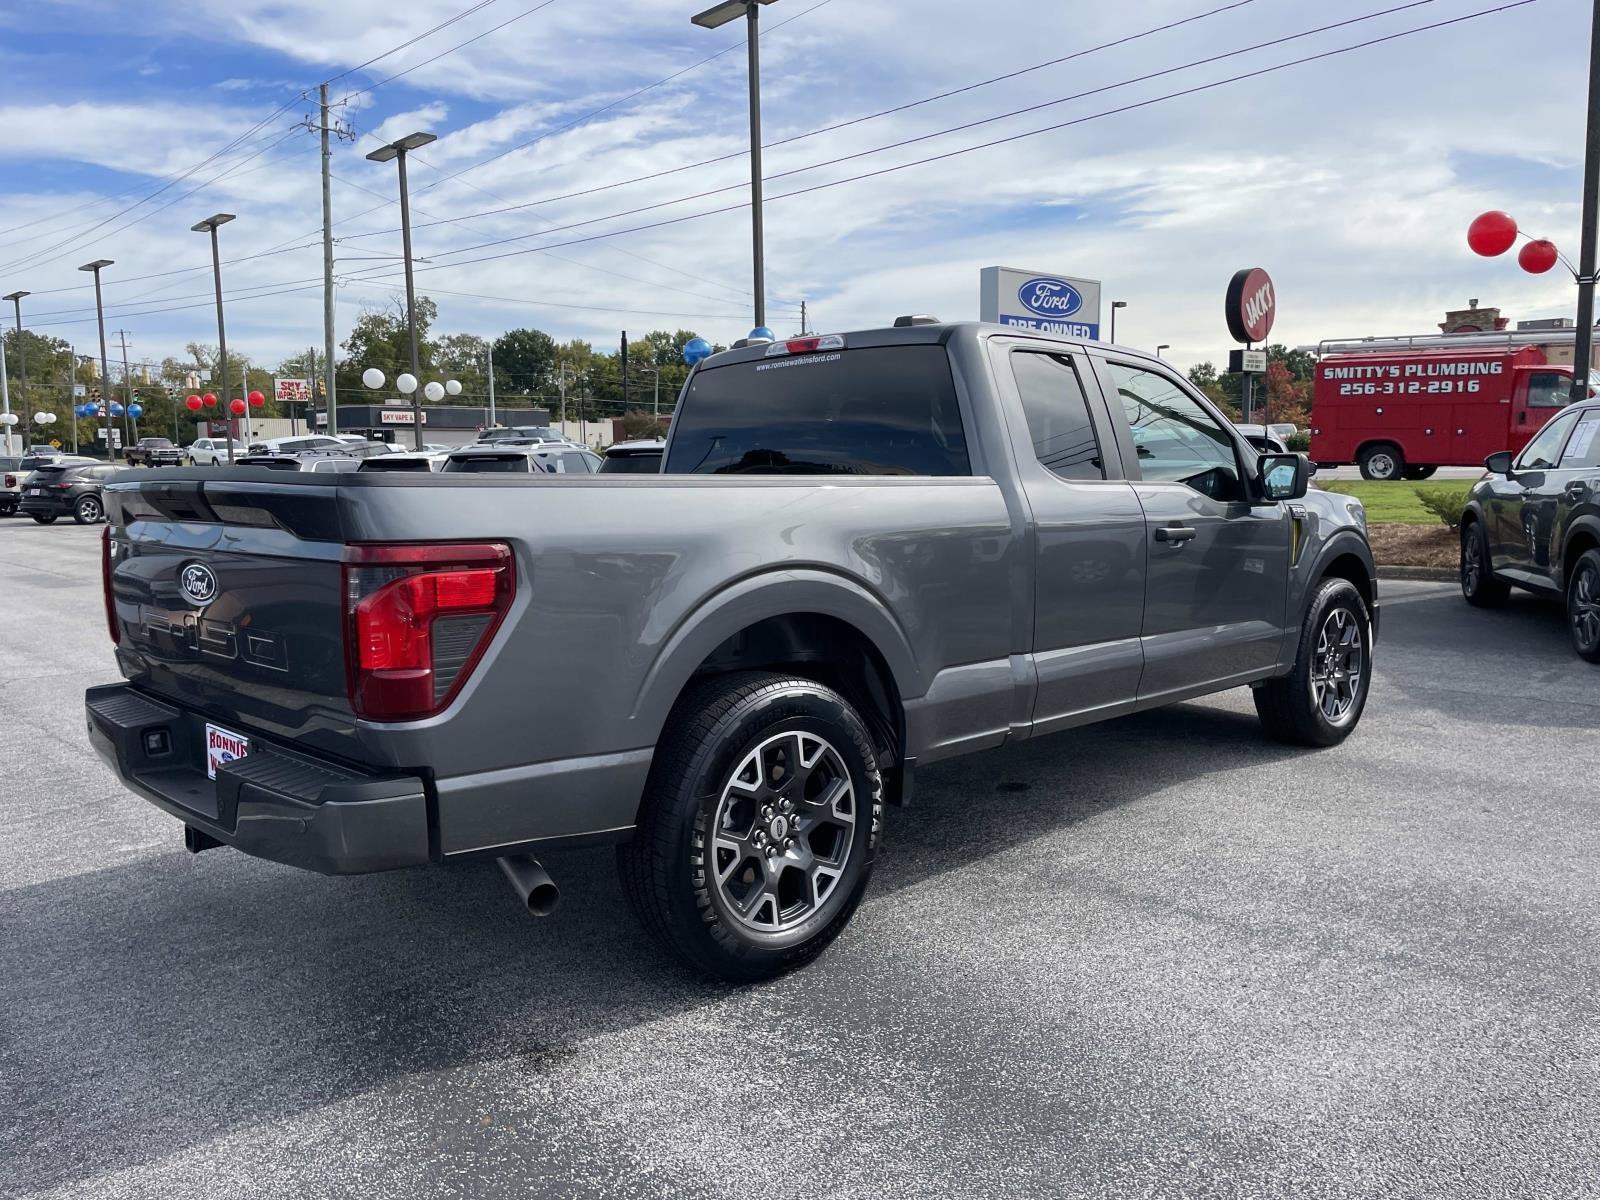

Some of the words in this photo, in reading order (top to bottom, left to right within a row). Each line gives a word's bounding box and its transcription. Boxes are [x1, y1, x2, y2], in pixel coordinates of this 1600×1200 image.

[1031, 282, 1070, 310] Ford
[1323, 365, 1400, 380] SMITTY'S
[1404, 361, 1503, 377] PLUMBING
[1340, 380, 1480, 396] 256-312-2916
[383, 412, 394, 421] SKY
[395, 412, 408, 422] VAPE
[186, 568, 209, 595] Ford
[209, 731, 248, 758] RONNIE
